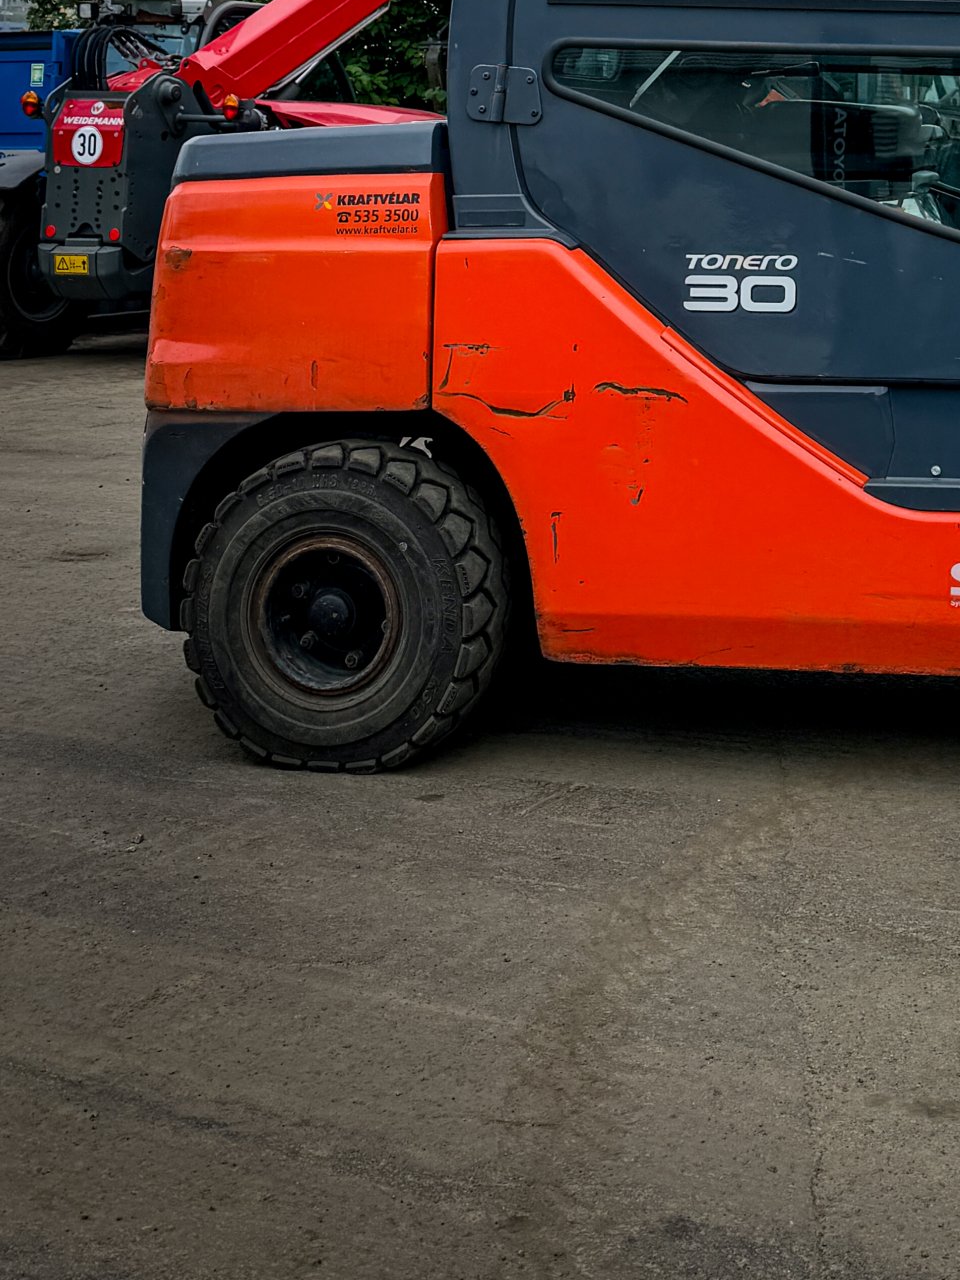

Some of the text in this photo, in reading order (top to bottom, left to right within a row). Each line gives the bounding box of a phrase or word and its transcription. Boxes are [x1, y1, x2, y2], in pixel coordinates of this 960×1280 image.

[63, 116, 125, 126] WEIDEMANN
[77, 133, 97, 157] 30
[336, 192, 420, 206] KRAFTVÉLAR
[353, 208, 419, 223] 535 3500
[336, 224, 418, 235] www.kraftvelar.is
[683, 274, 797, 313] 30
